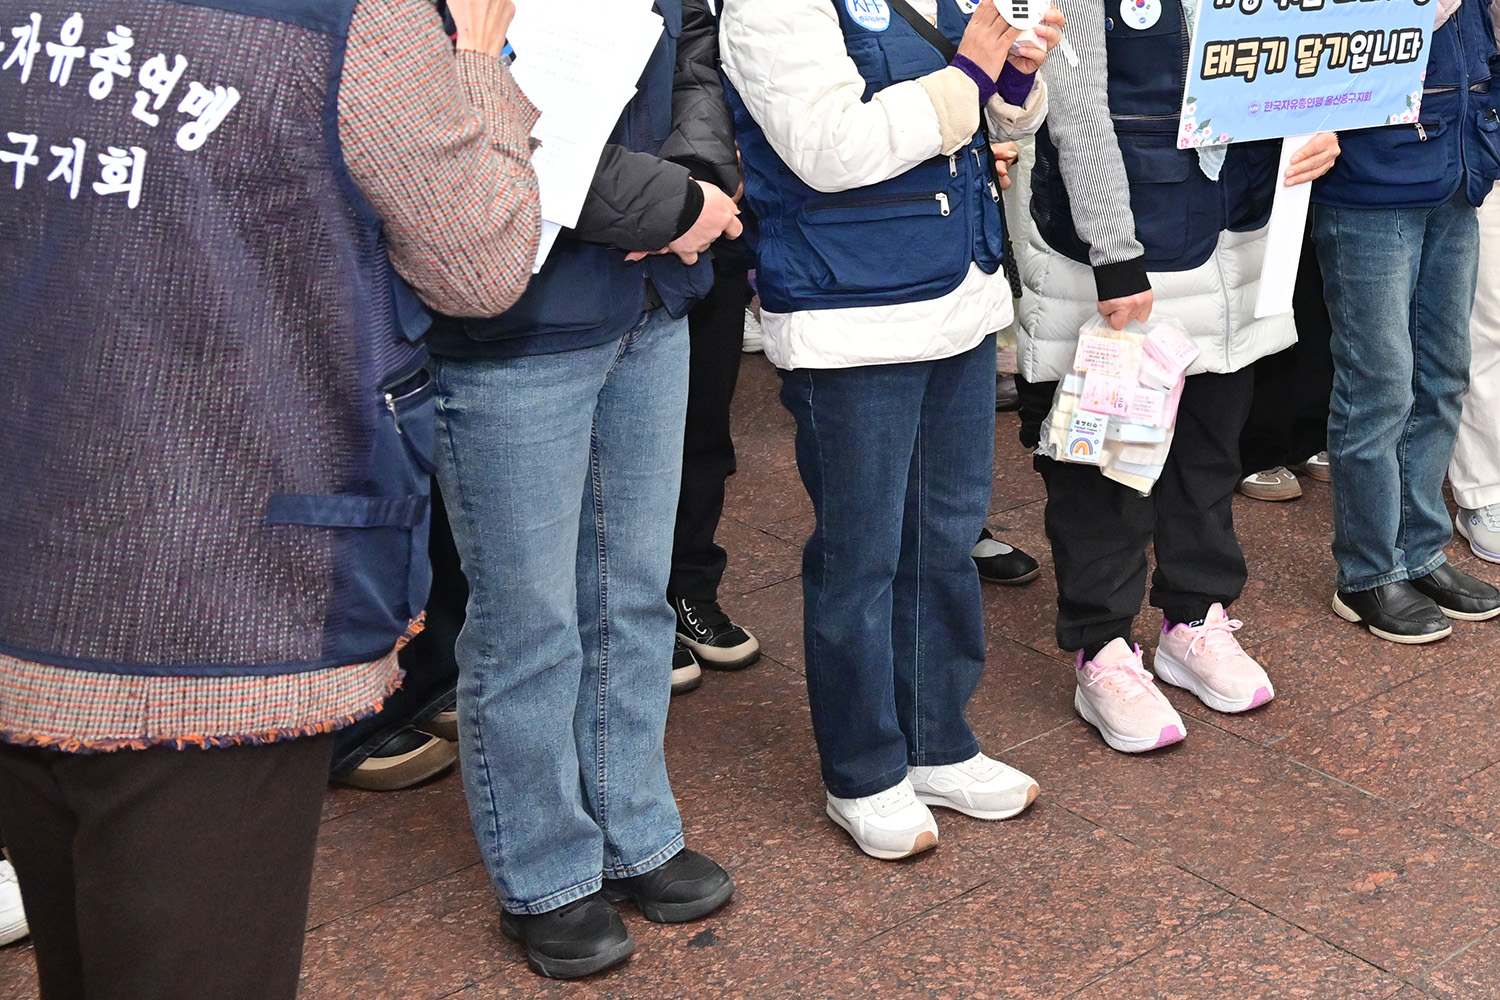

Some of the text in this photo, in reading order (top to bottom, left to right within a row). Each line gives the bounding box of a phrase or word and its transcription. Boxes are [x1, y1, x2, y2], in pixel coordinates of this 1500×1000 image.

[1202, 29, 1422, 82] 태극기 달기입니다
[1263, 96, 1325, 113] 한국자유총연맹
[1324, 91, 1373, 107] 울산중구지회
